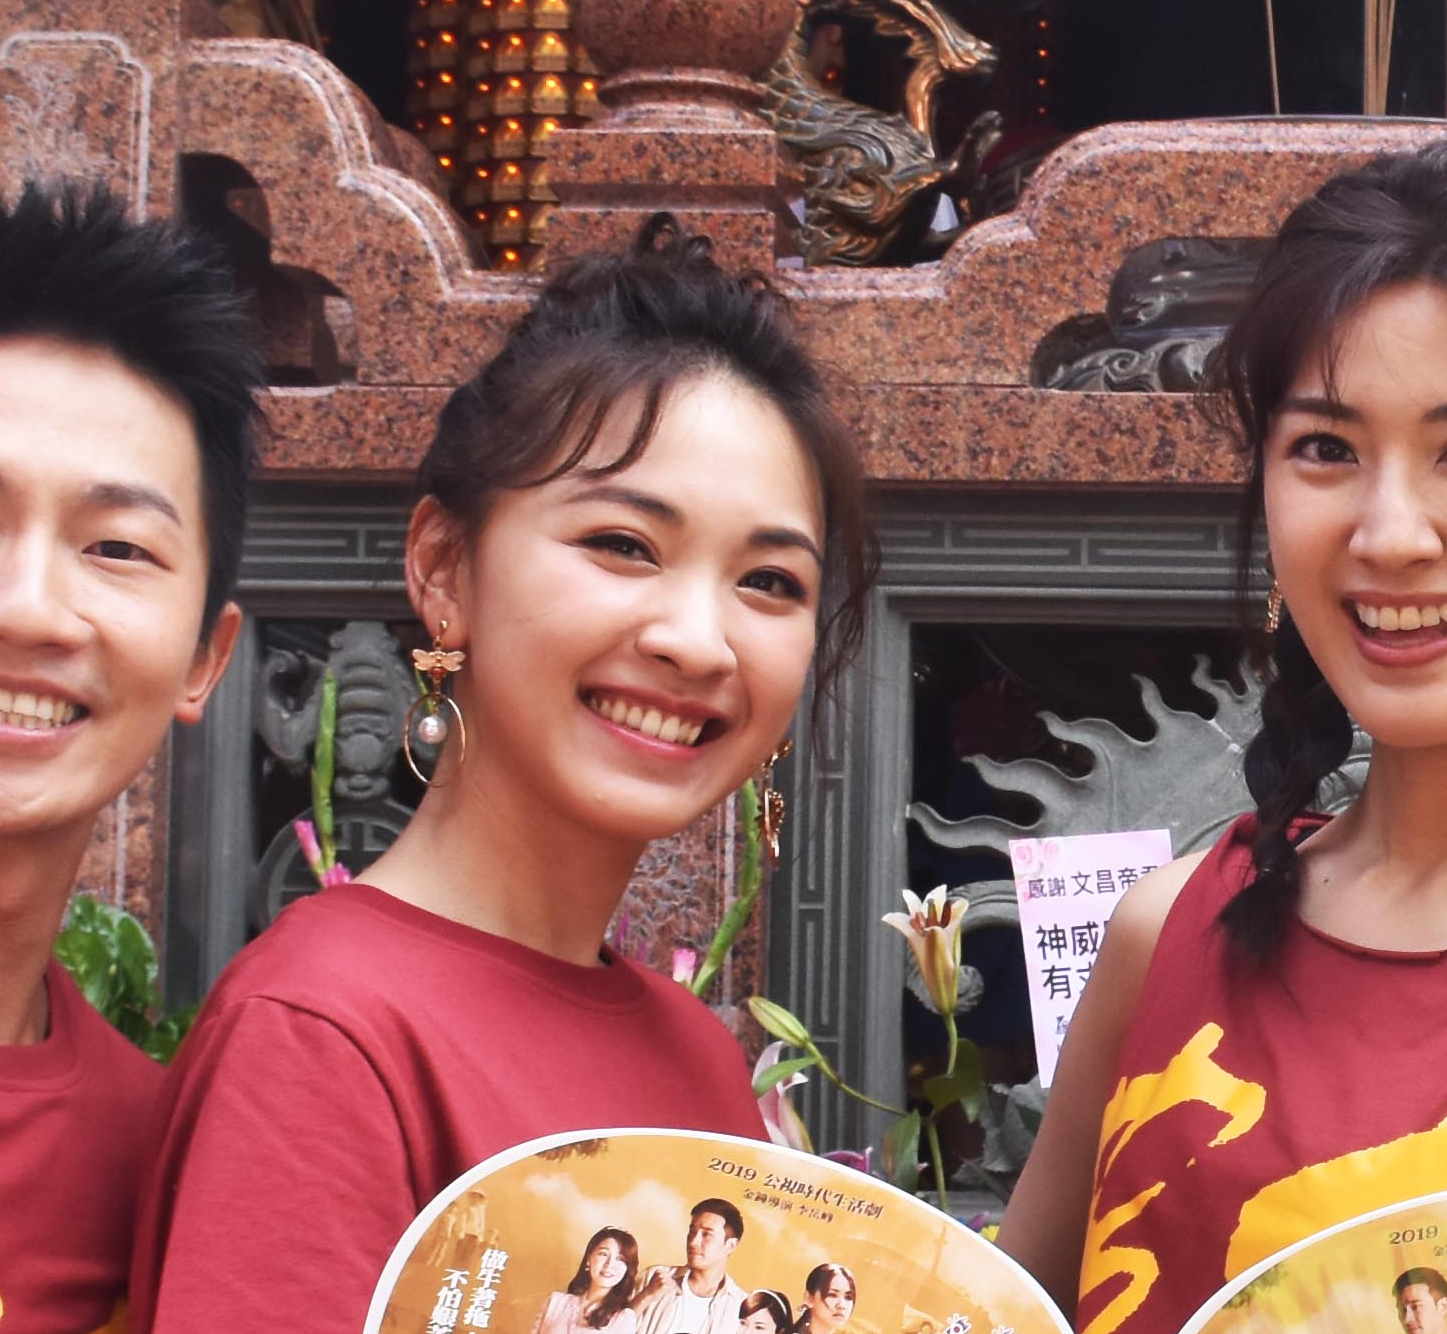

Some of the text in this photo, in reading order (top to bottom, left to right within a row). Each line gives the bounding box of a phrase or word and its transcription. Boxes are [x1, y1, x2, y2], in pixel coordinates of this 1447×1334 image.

[1028, 876, 1067, 899] 感謝
[1036, 920, 1109, 961] 神威
[707, 1157, 884, 1220] 2019 公視時代生活劇
[1389, 1225, 1438, 1245] 2019
